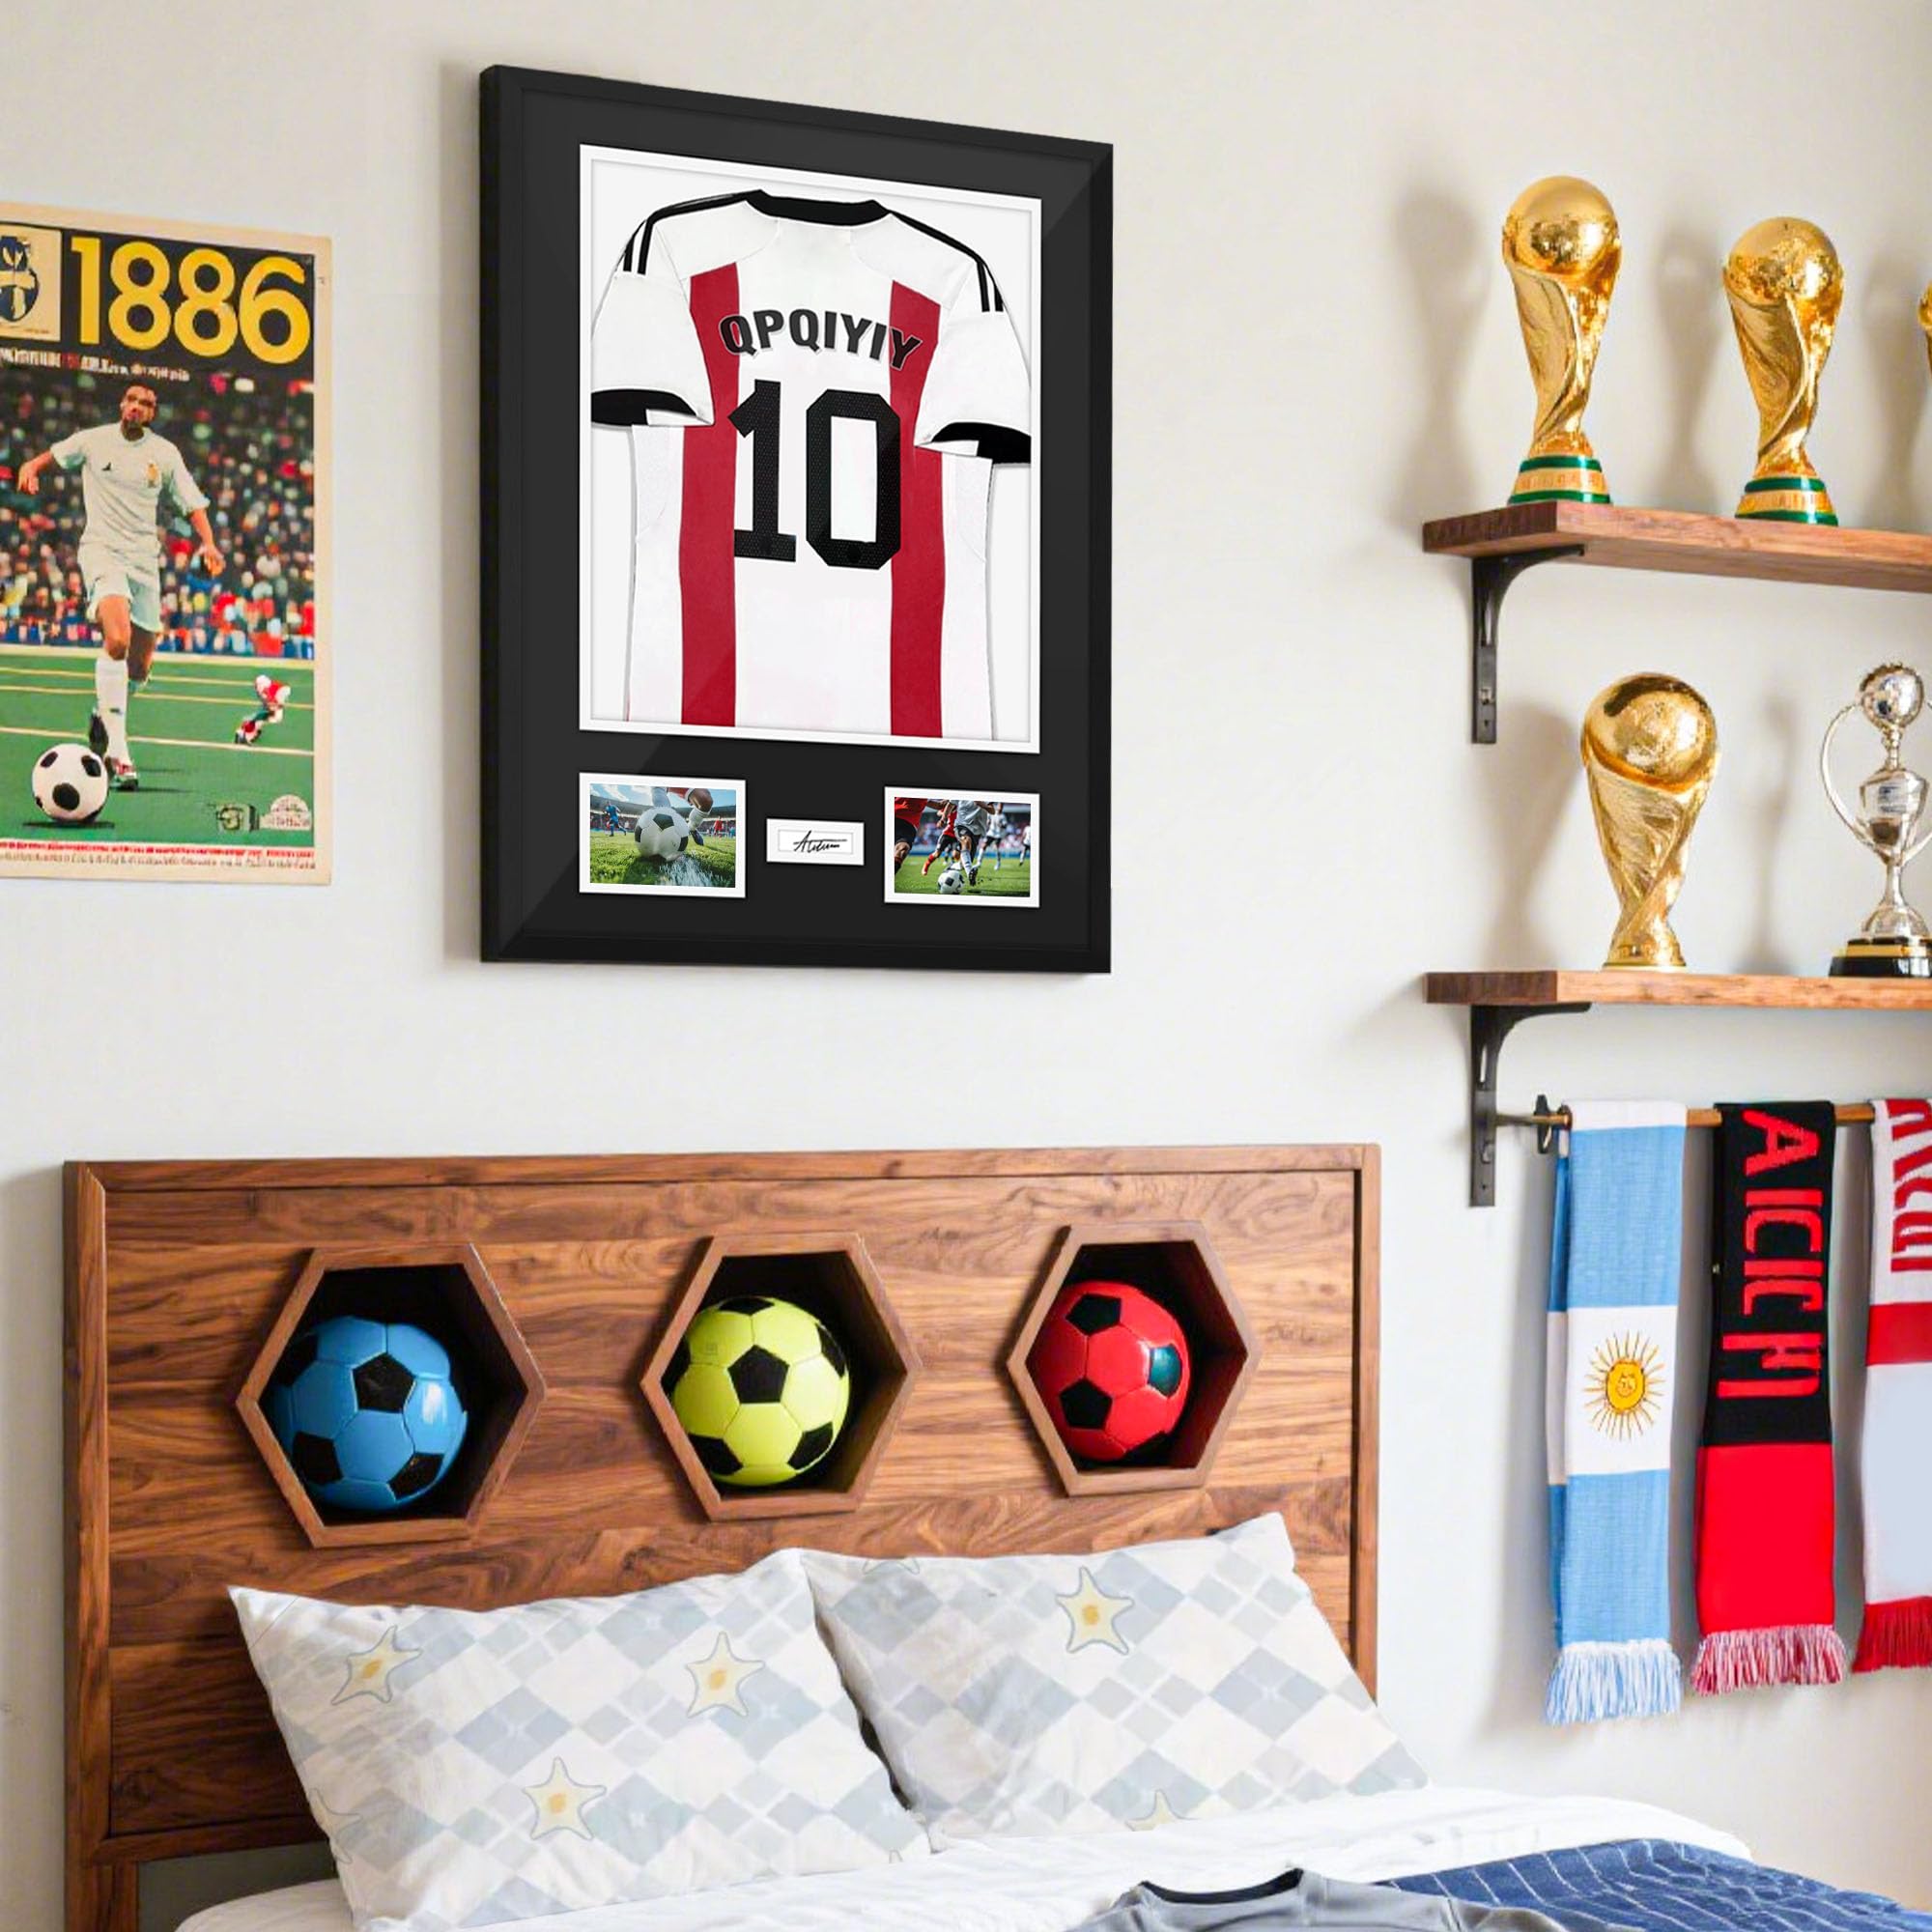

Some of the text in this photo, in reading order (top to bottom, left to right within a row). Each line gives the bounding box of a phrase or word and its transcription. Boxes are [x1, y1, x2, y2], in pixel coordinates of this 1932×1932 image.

[71, 236, 311, 365] 1886
[719, 309, 922, 369] QPQIYIY
[727, 379, 902, 570] 10
